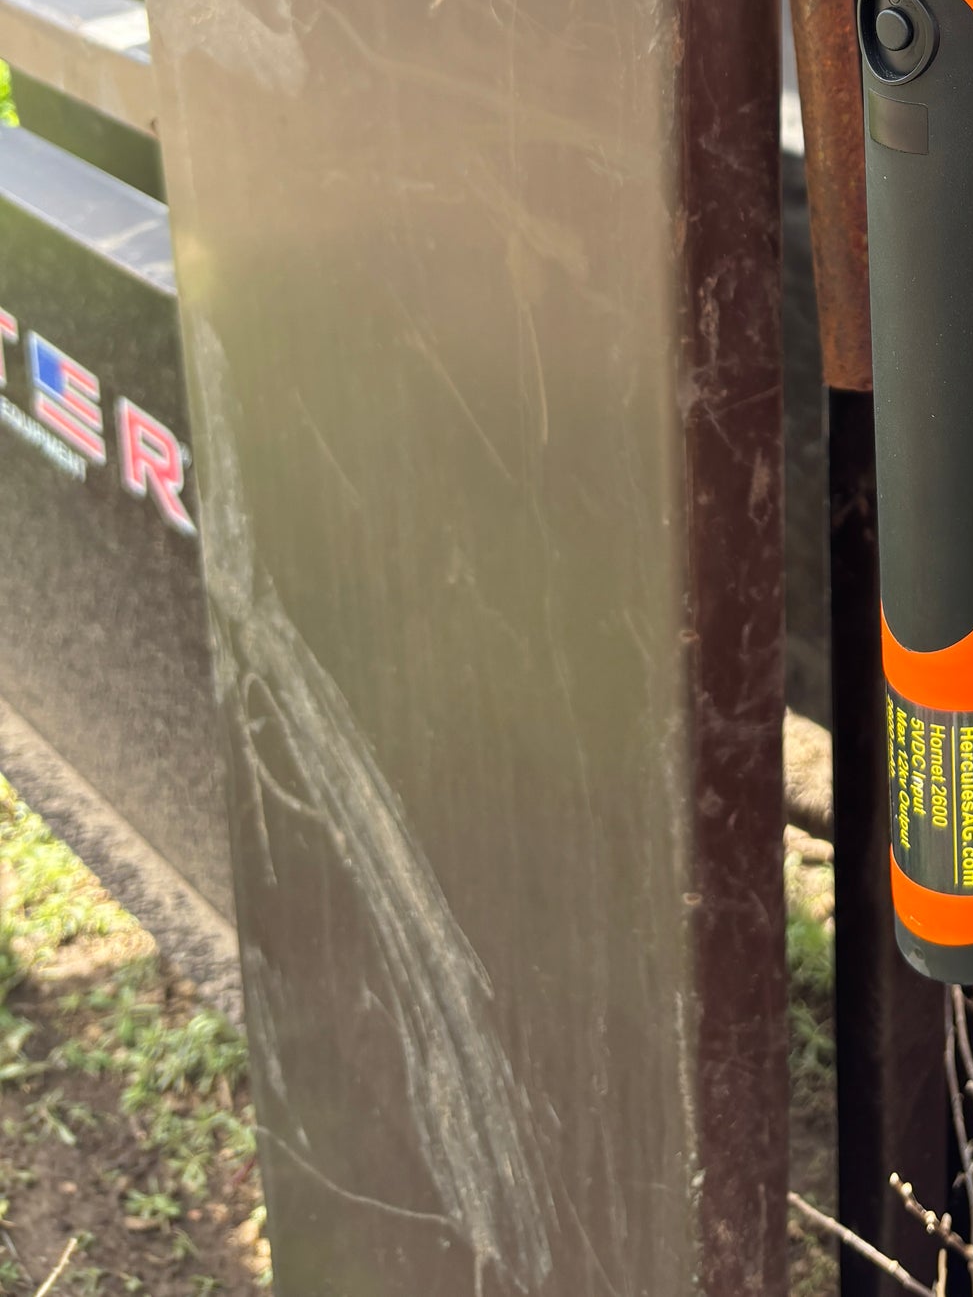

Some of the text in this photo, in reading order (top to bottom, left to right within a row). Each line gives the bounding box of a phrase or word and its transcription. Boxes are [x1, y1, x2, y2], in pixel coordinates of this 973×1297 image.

[896, 706, 907, 745] Max
[911, 716, 926, 816] 5VDC Input
[930, 723, 948, 829] Hornet 2600
[899, 789, 911, 850] Output
